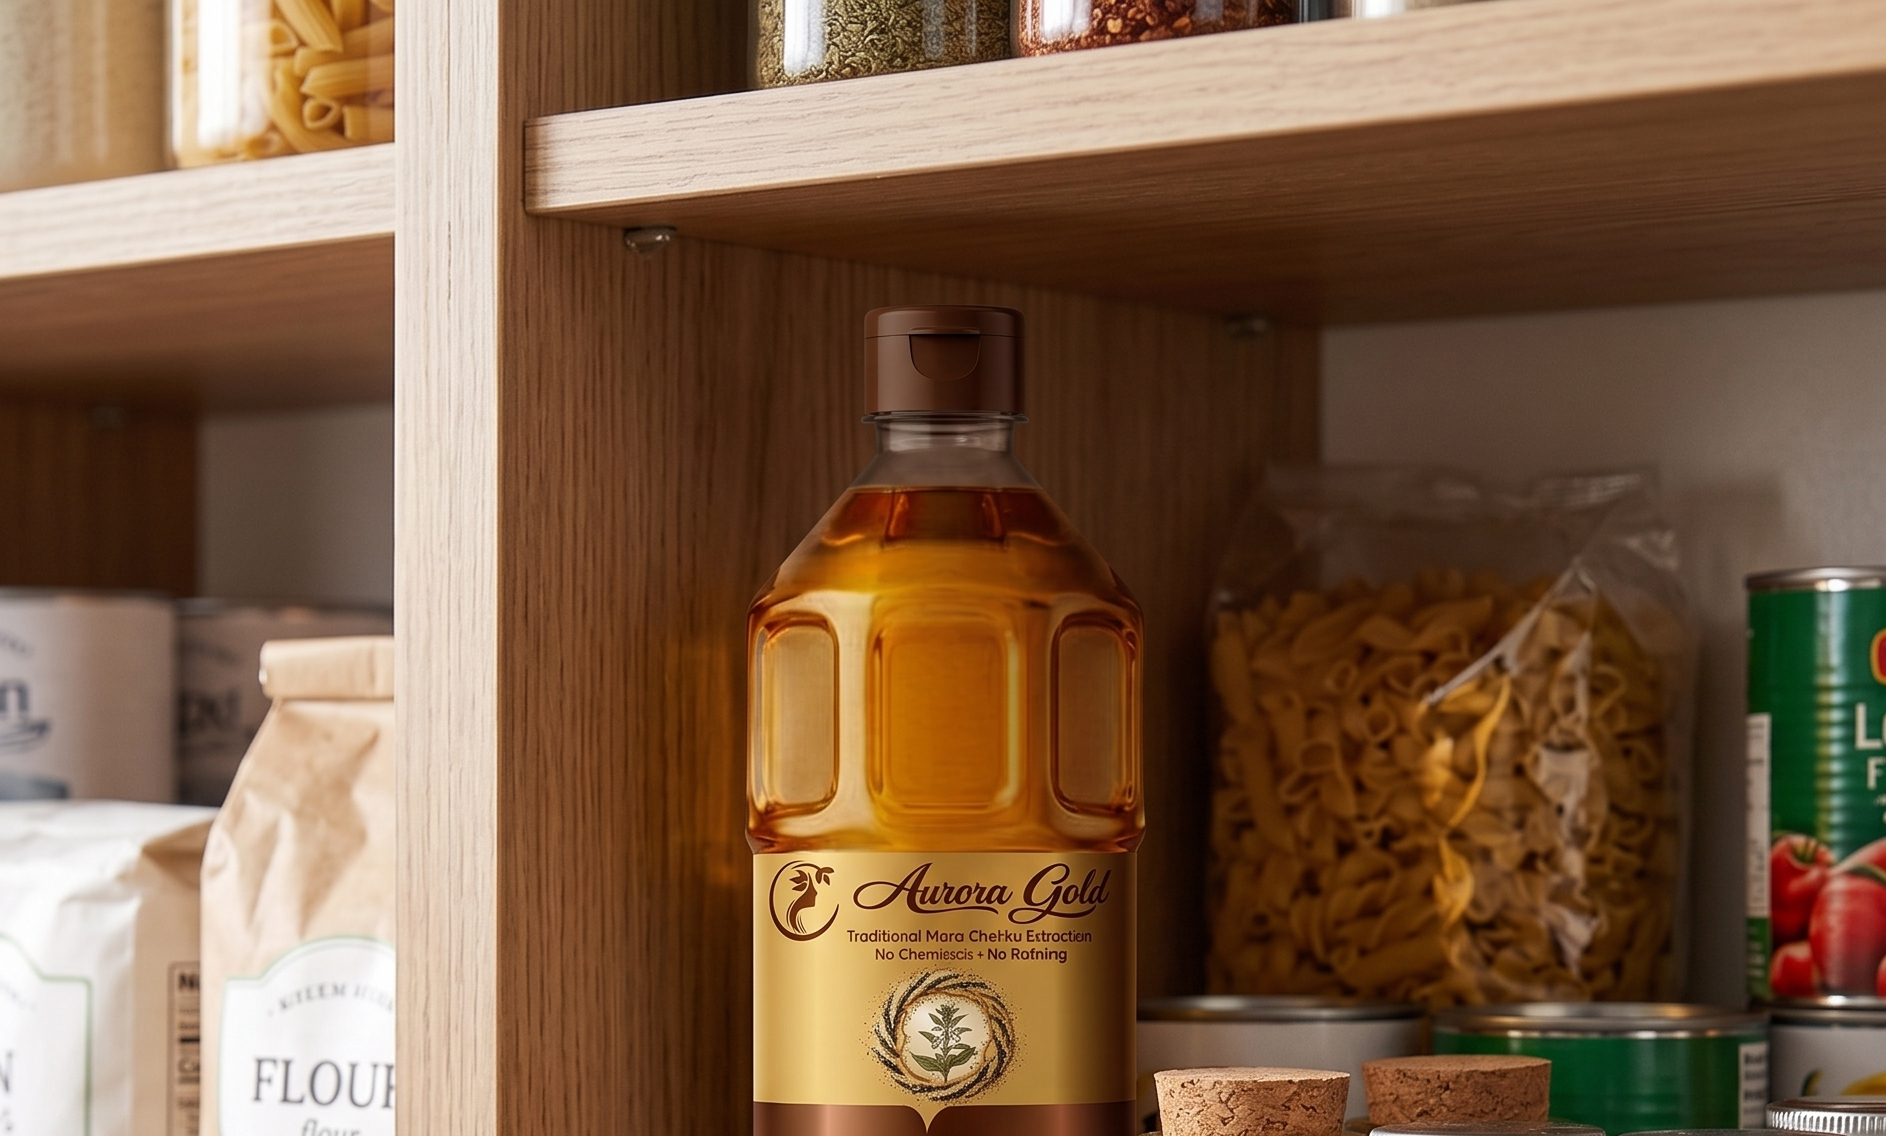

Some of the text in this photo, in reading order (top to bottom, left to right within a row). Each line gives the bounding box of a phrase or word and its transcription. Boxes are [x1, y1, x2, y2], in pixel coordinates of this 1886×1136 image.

[853, 862, 1113, 925] Aurora Gold
[847, 929, 921, 943] Traditional
[875, 949, 894, 960] No
[987, 948, 1007, 960] No
